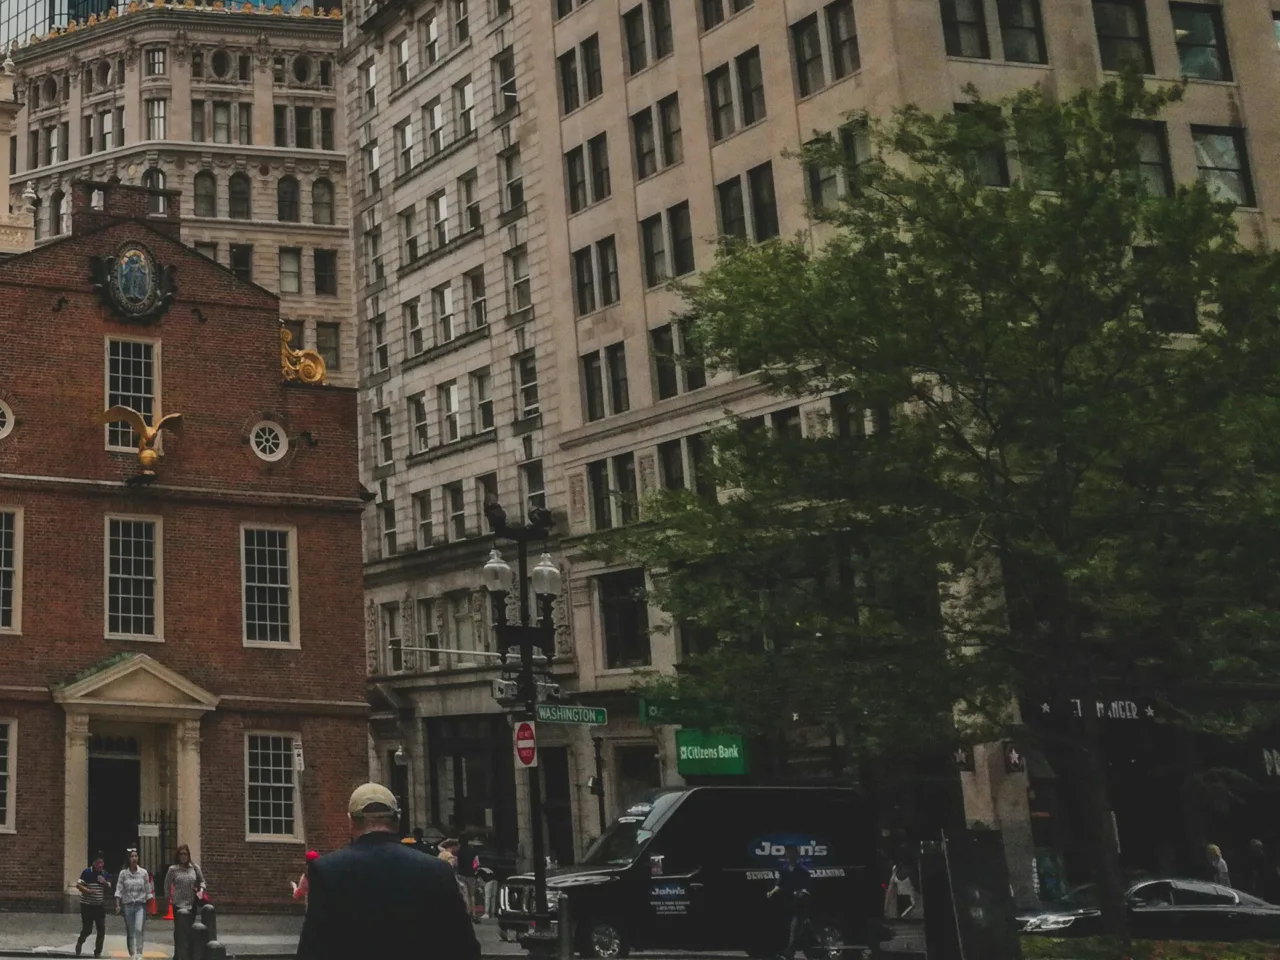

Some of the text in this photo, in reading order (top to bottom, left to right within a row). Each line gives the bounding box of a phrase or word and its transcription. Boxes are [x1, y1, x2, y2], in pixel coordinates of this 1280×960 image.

[538, 706, 596, 723] WASHINGTON
[687, 744, 739, 759] Citizens Bank
[754, 839, 828, 856] Jon's
[745, 870, 775, 880] SEWER
